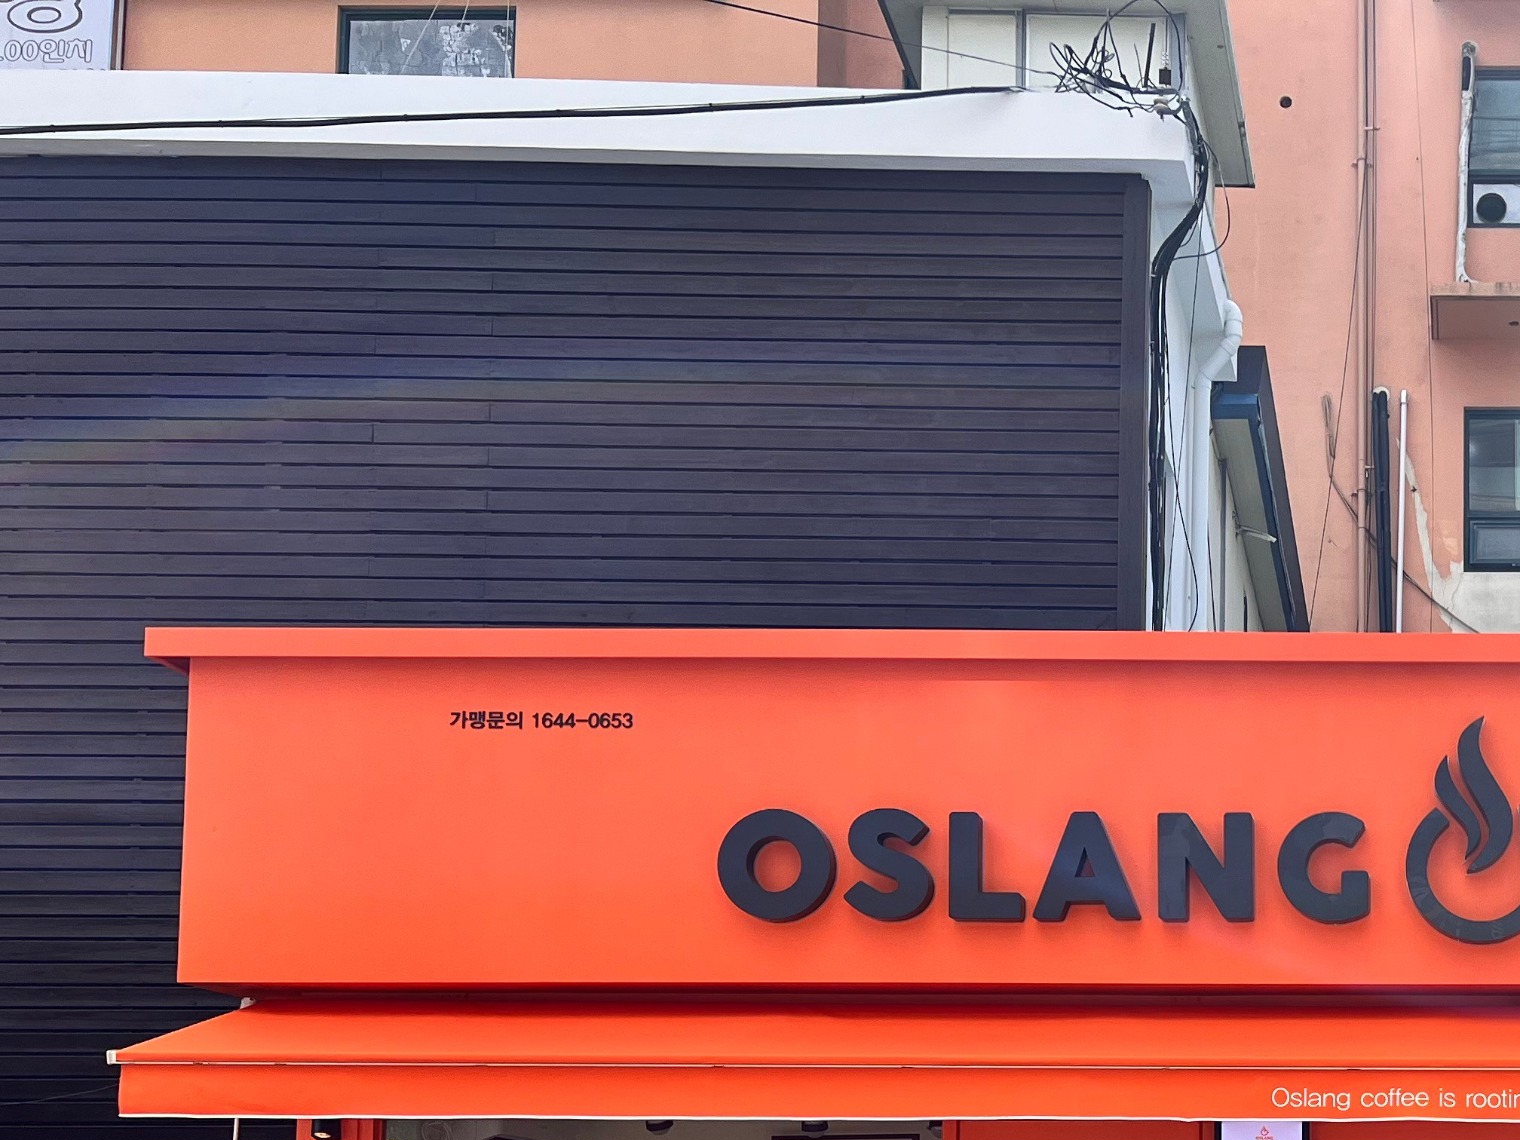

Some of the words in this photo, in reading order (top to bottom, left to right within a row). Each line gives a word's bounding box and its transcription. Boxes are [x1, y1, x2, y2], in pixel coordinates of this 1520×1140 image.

[0, 38, 93, 63] 00인치
[450, 710, 523, 730] 가맹문의
[532, 712, 633, 729] 1644-0653
[717, 808, 1371, 924] OSLANG
[1271, 1087, 1350, 1111] Oslang
[1360, 1087, 1429, 1108] coffee
[1439, 1087, 1456, 1108] is
